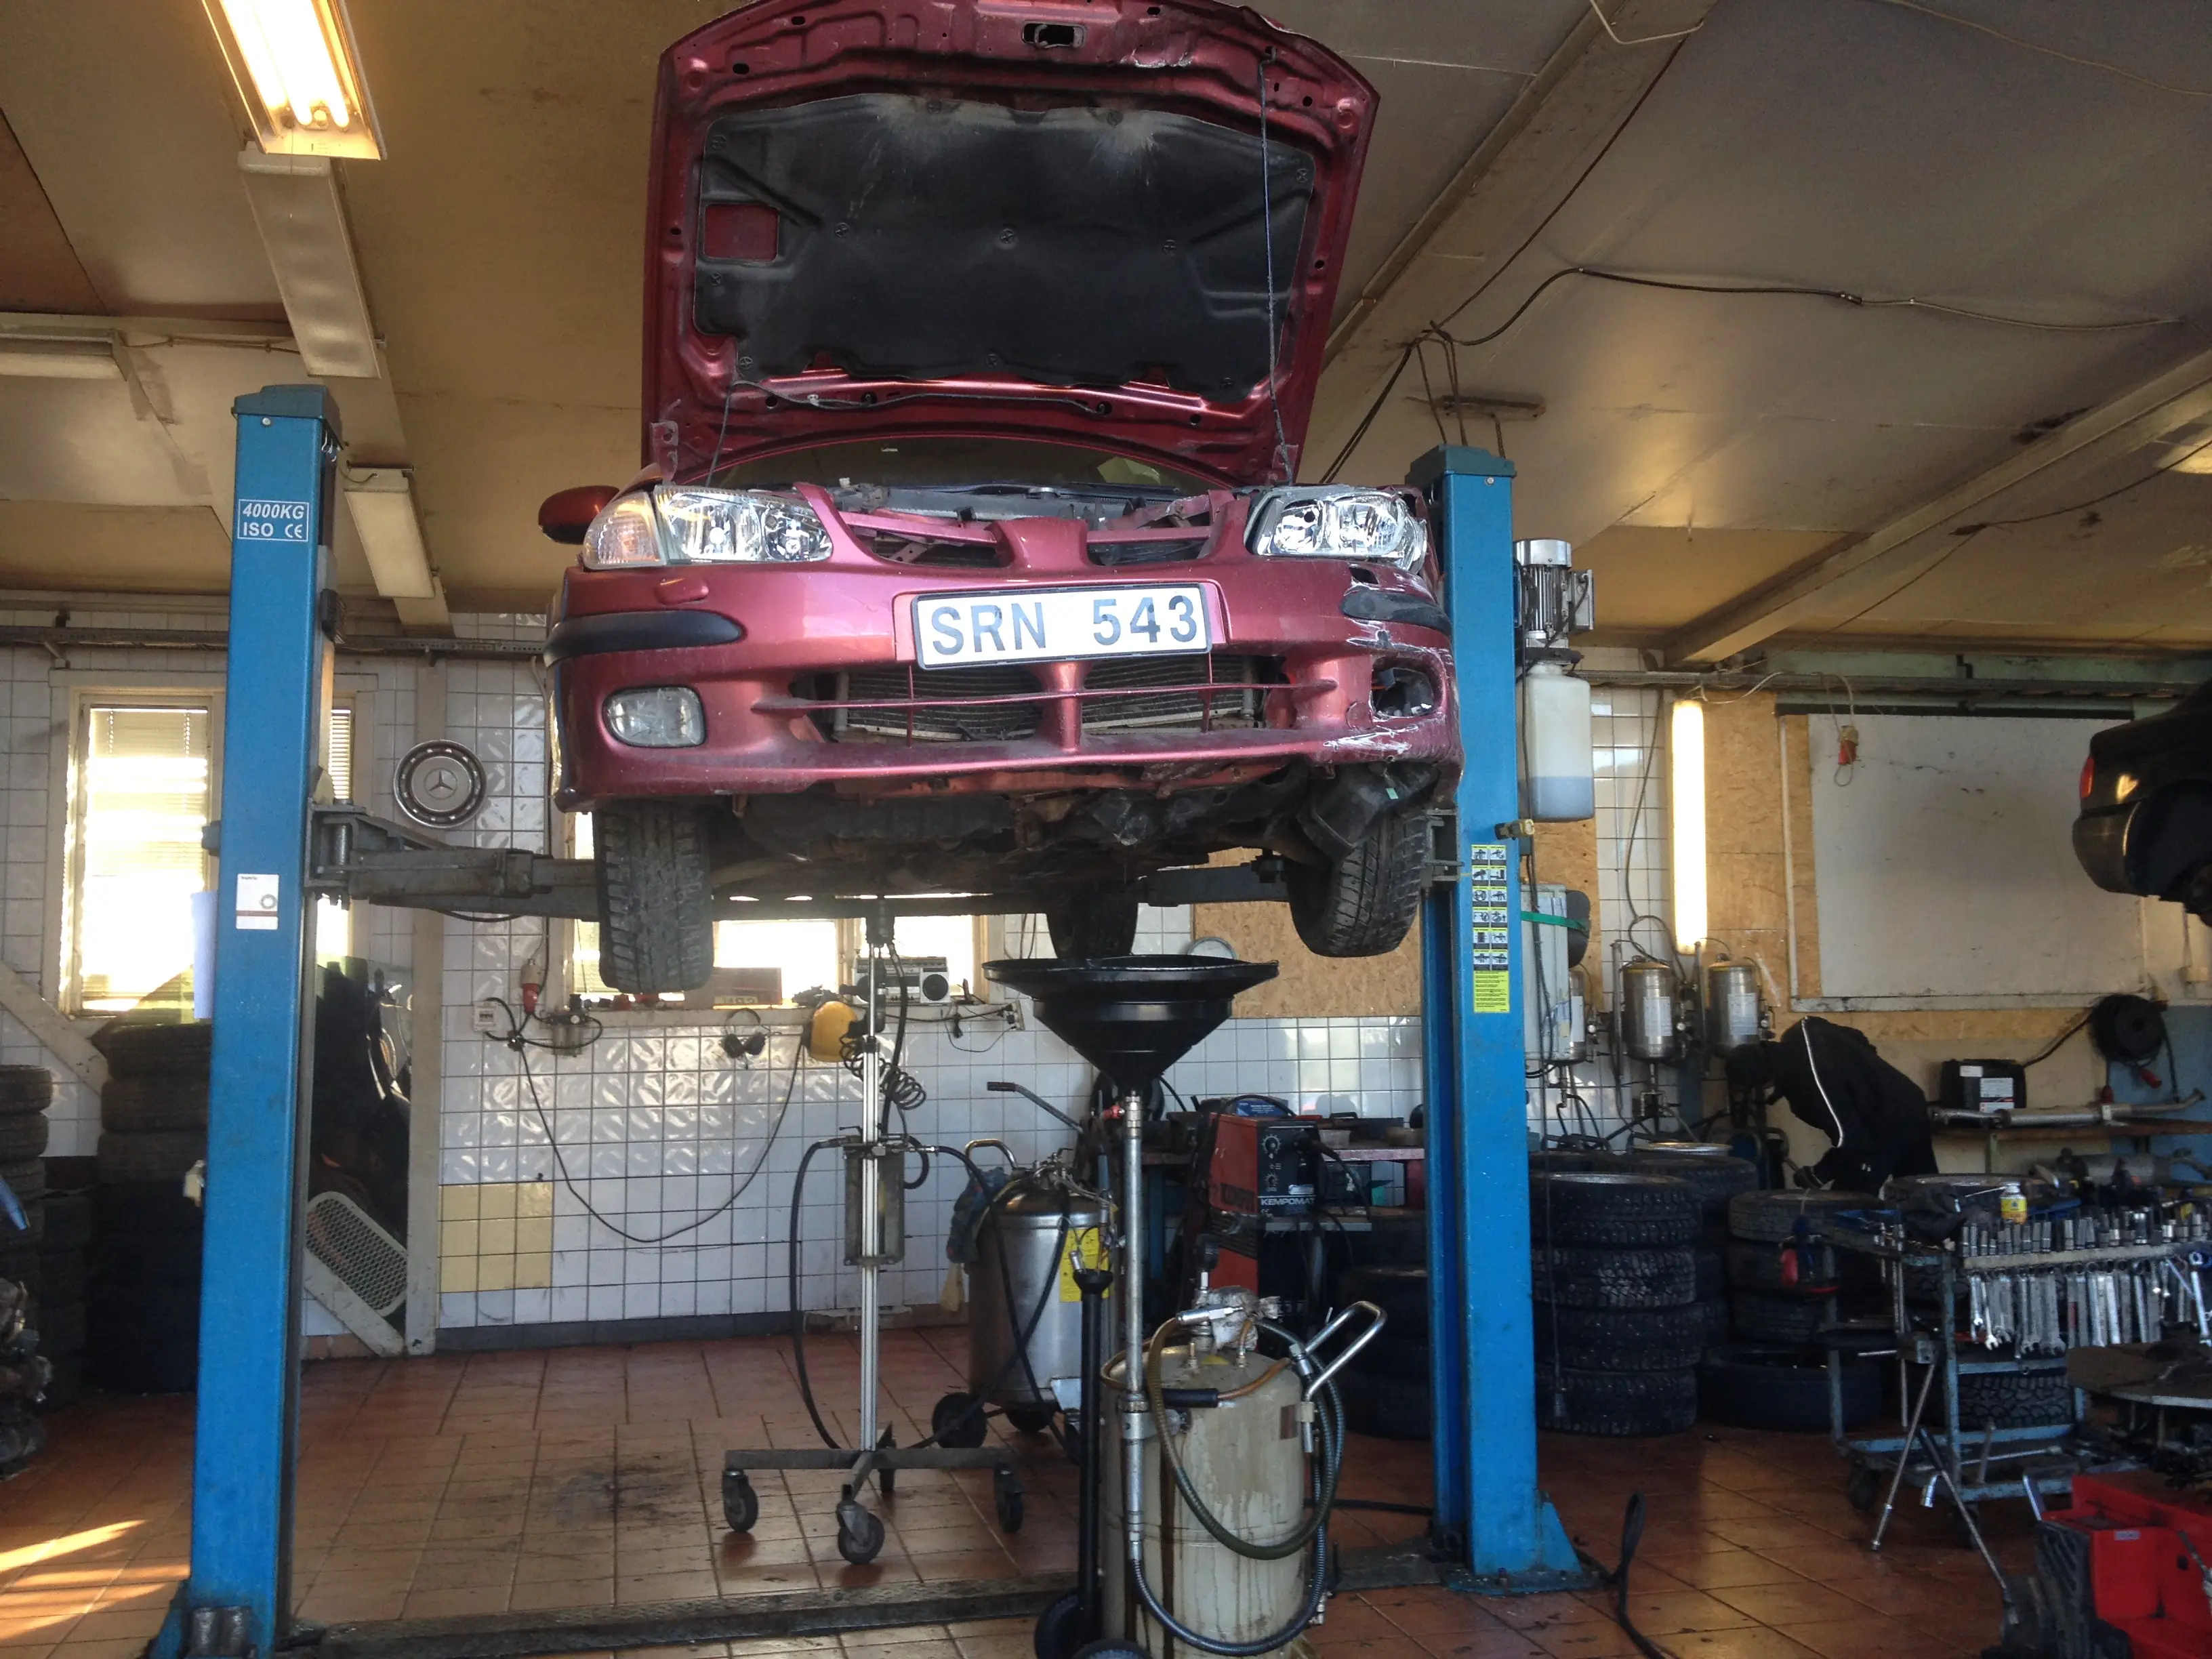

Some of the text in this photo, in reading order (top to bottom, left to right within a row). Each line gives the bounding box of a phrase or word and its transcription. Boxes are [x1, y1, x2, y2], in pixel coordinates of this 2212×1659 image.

[243, 503, 304, 519] 4000KG
[243, 522, 274, 537] ISO
[930, 595, 1197, 655] SRN 543
[1261, 1197, 1315, 1206] KEMPOMAT
